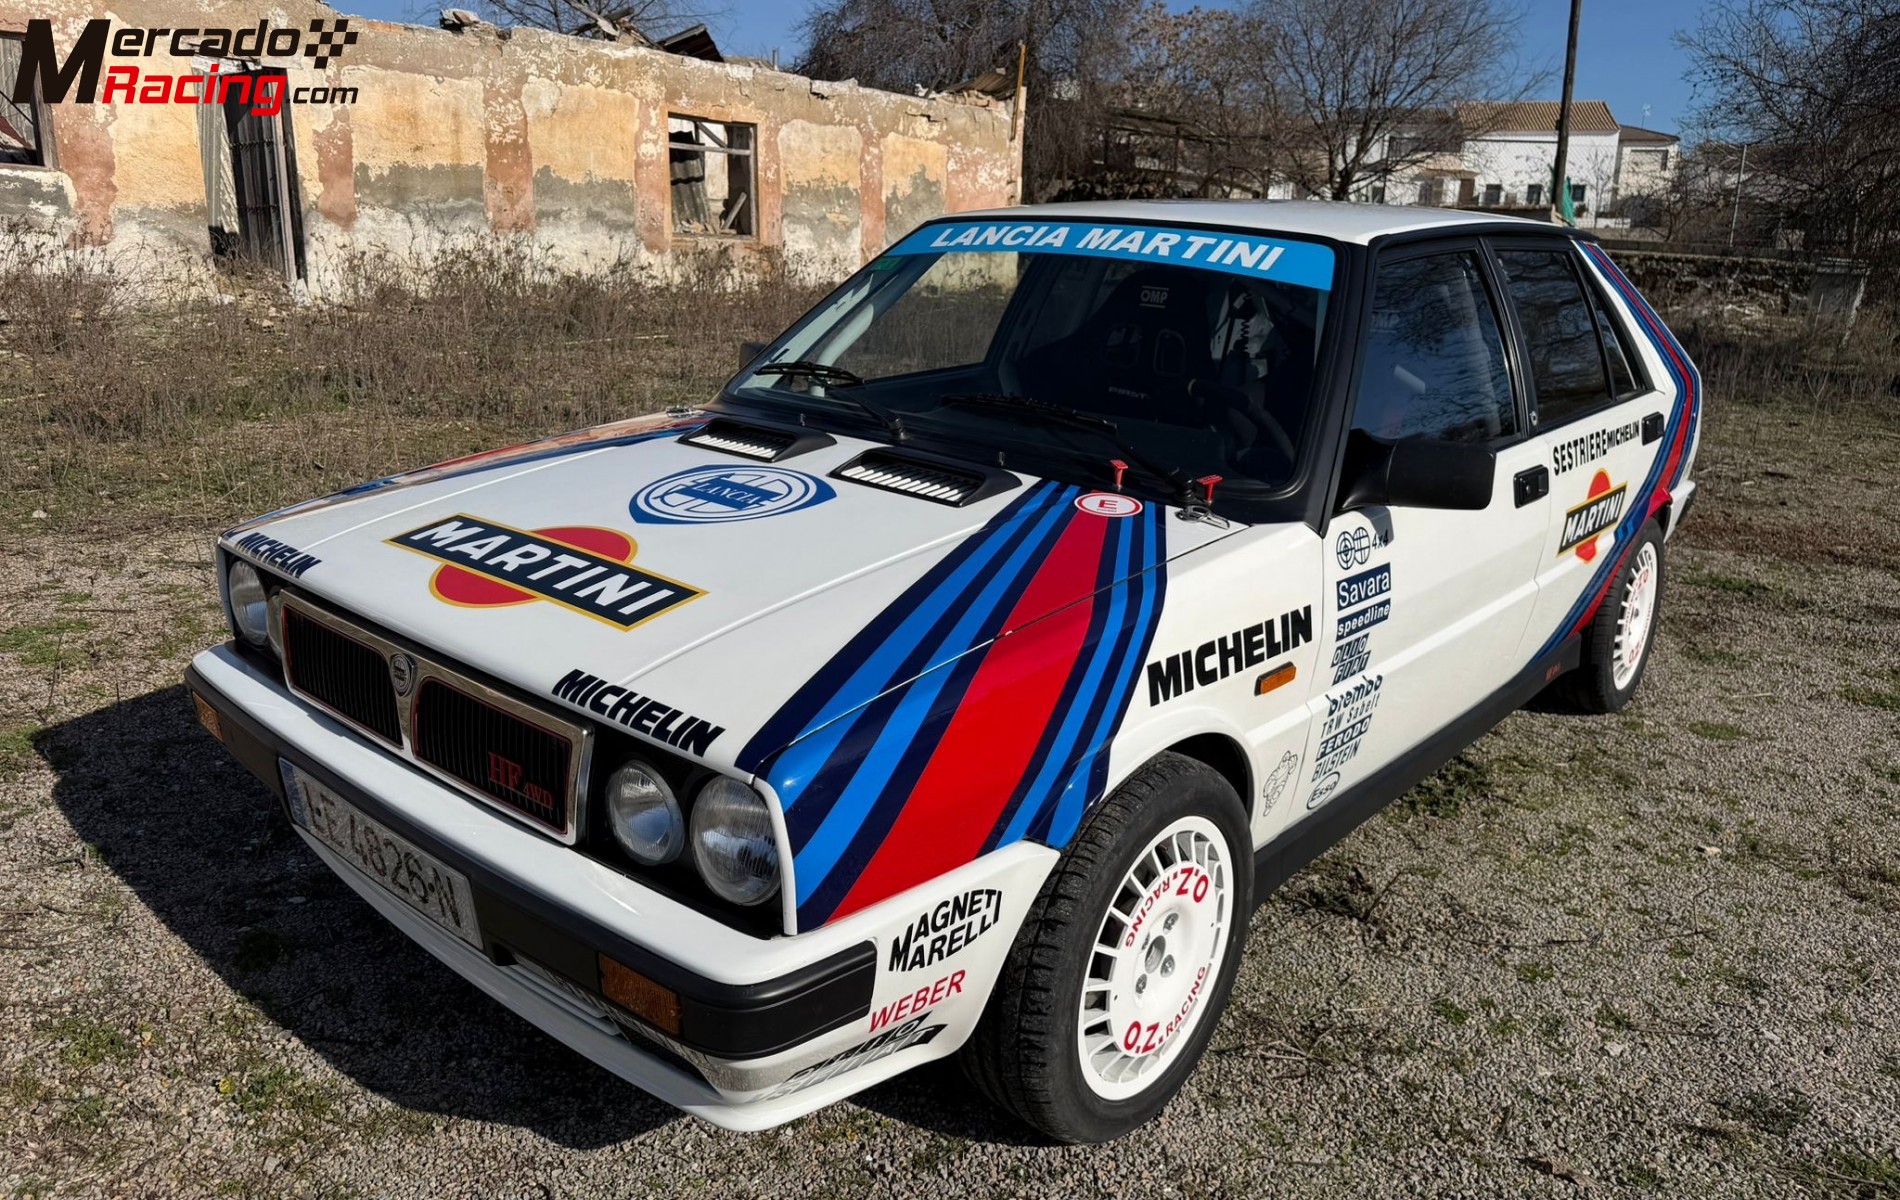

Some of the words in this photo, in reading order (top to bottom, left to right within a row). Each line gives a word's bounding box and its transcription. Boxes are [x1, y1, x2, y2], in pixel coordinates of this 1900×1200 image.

[930, 225, 1069, 248] LANCIA
[1076, 228, 1285, 272] MARTINI
[1140, 290, 1168, 304] OMP
[1553, 428, 1608, 476] SESTRIERE
[1607, 420, 1640, 450] MICHELIN
[691, 482, 762, 504] LANCIA
[1372, 529, 1389, 550] 4x4
[1562, 491, 1625, 547] MARTINI
[235, 531, 322, 579] MICHELIN
[409, 520, 674, 616] MARTINI
[1339, 571, 1390, 607] Savara
[1337, 603, 1390, 637] speedline
[1147, 604, 1312, 707] MICHELIN
[1332, 636, 1369, 666] OLIO
[1334, 652, 1371, 683] FIAT
[551, 669, 726, 758] MICHELIN
[1320, 711, 1345, 739] TRW
[1346, 692, 1381, 724] Sabelt
[1325, 674, 1384, 717] brembo
[1311, 737, 1362, 783] BILSTEIN
[1317, 717, 1371, 758] FERODO
[488, 751, 525, 791] HF
[1310, 780, 1338, 802] Esso
[523, 782, 555, 810] 4WD
[889, 889, 1002, 962] MAGNETI
[889, 898, 1002, 972] MARELLI
[1125, 876, 1172, 948] RACING
[868, 969, 966, 1033] WEBER
[1165, 965, 1207, 1038] RACING
